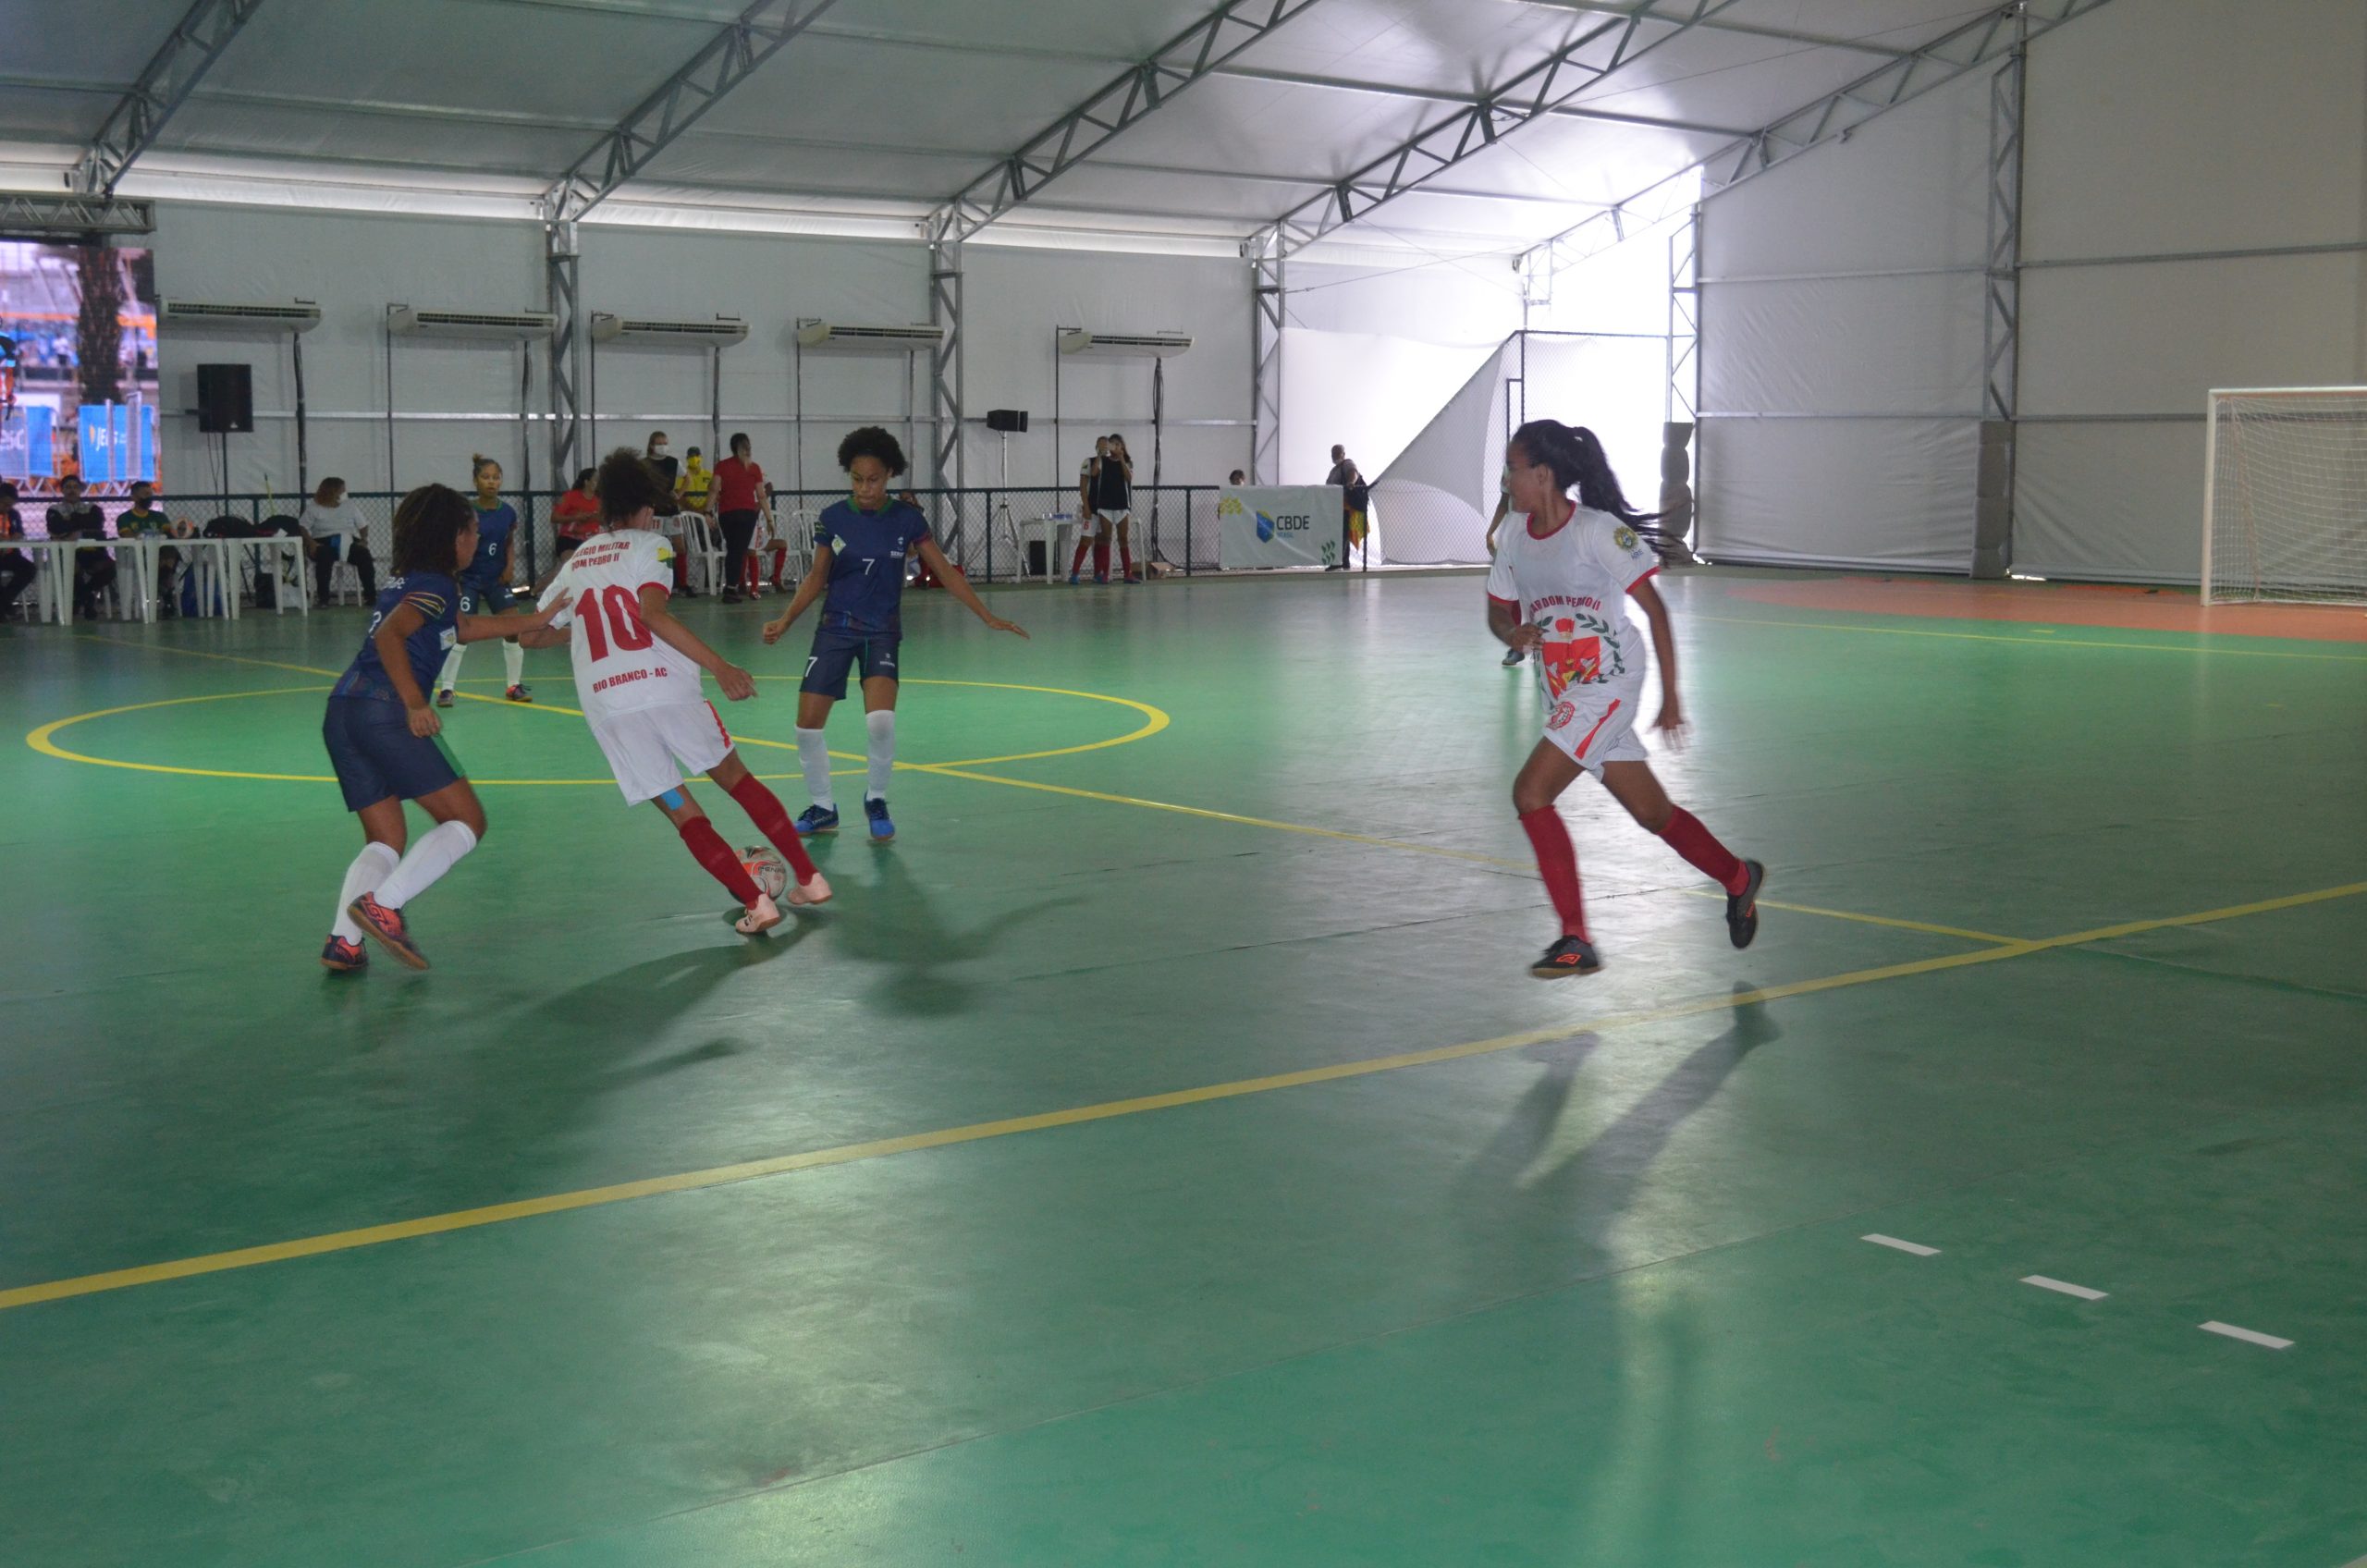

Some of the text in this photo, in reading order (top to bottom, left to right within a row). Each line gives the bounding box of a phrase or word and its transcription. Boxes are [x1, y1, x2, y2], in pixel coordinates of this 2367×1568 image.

[1277, 515, 1310, 531] CBDE
[488, 543, 497, 557] 6
[597, 541, 632, 553] MILITAR
[588, 554, 612, 567] PEDRO
[862, 558, 875, 576] 7
[460, 596, 472, 613] 6
[1541, 594, 1564, 607] DOM
[574, 584, 654, 663] 10
[804, 656, 818, 678] 7
[592, 679, 608, 693] RIO
[608, 668, 648, 687] BRANCO
[655, 667, 668, 678] AC
